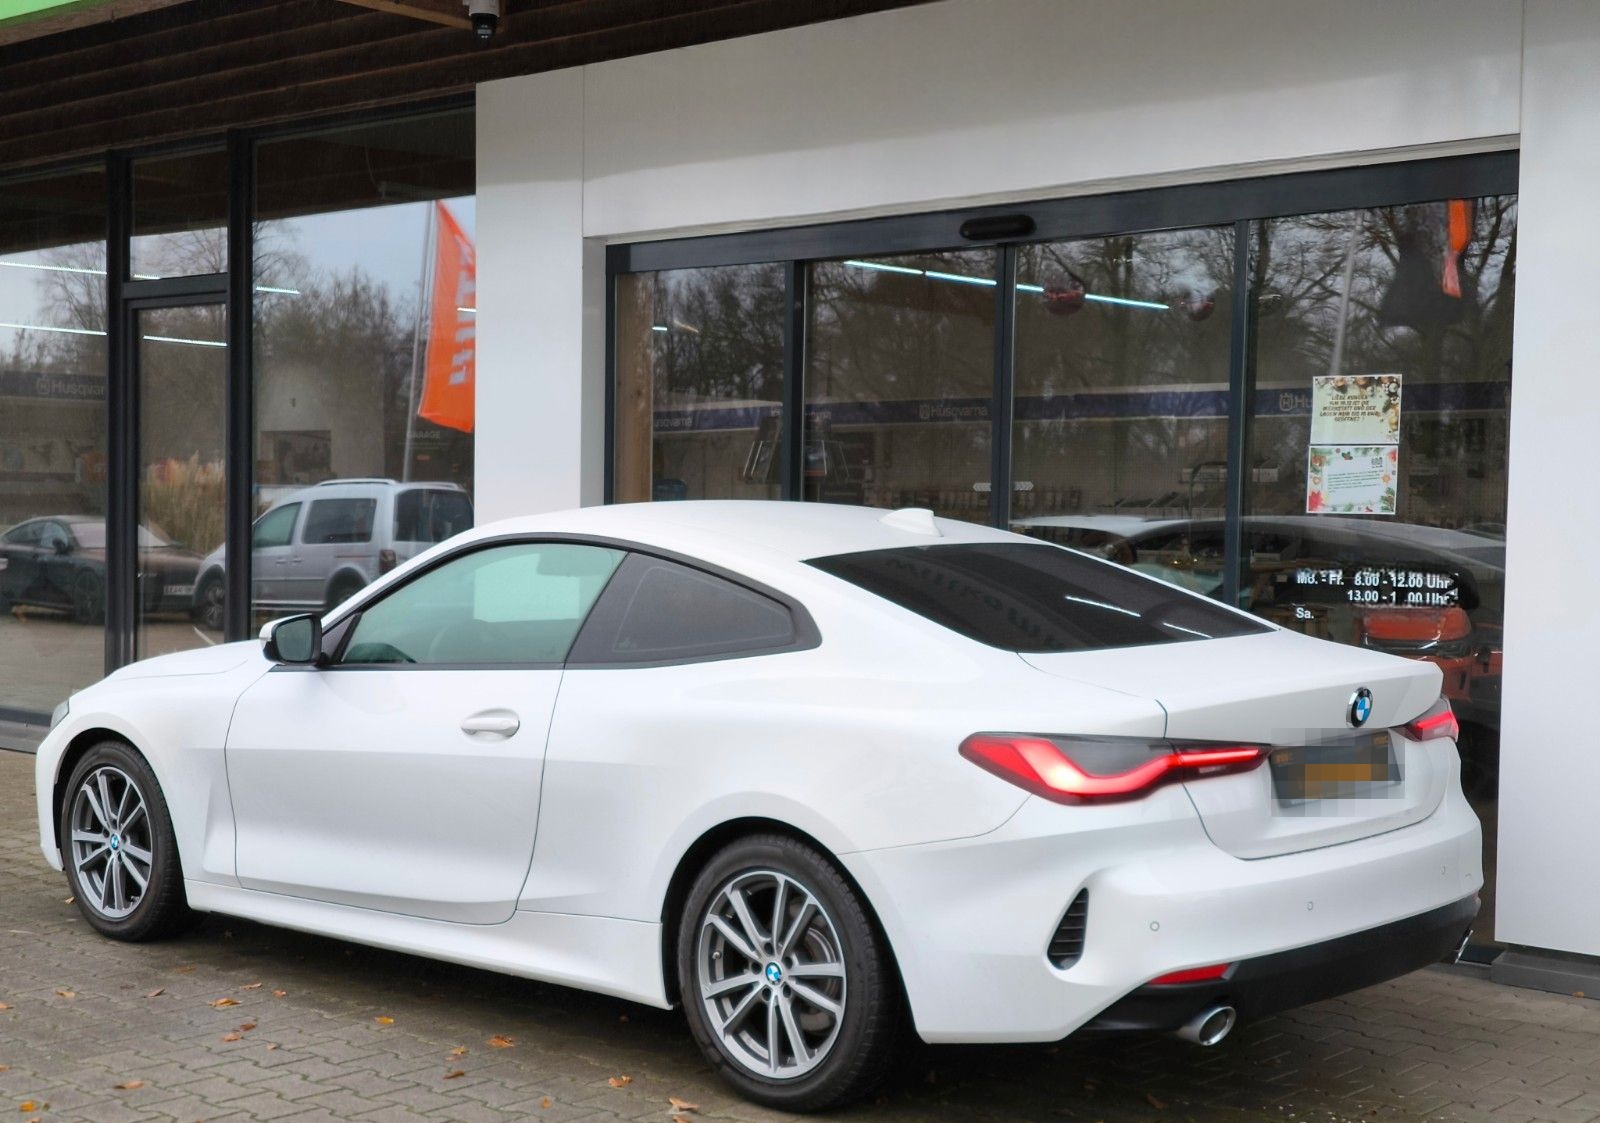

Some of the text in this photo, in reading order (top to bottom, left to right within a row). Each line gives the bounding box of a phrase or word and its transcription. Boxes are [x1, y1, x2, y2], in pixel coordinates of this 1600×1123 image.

[51, 381, 105, 397] Husqvar
[1353, 572, 1380, 587] 8.00
[1391, 573, 1424, 588] 12.00
[1425, 576, 1451, 590] Uhr
[1348, 589, 1379, 602] 13.00
[1390, 591, 1423, 604] 1.00
[1295, 607, 1315, 620] Sa.
